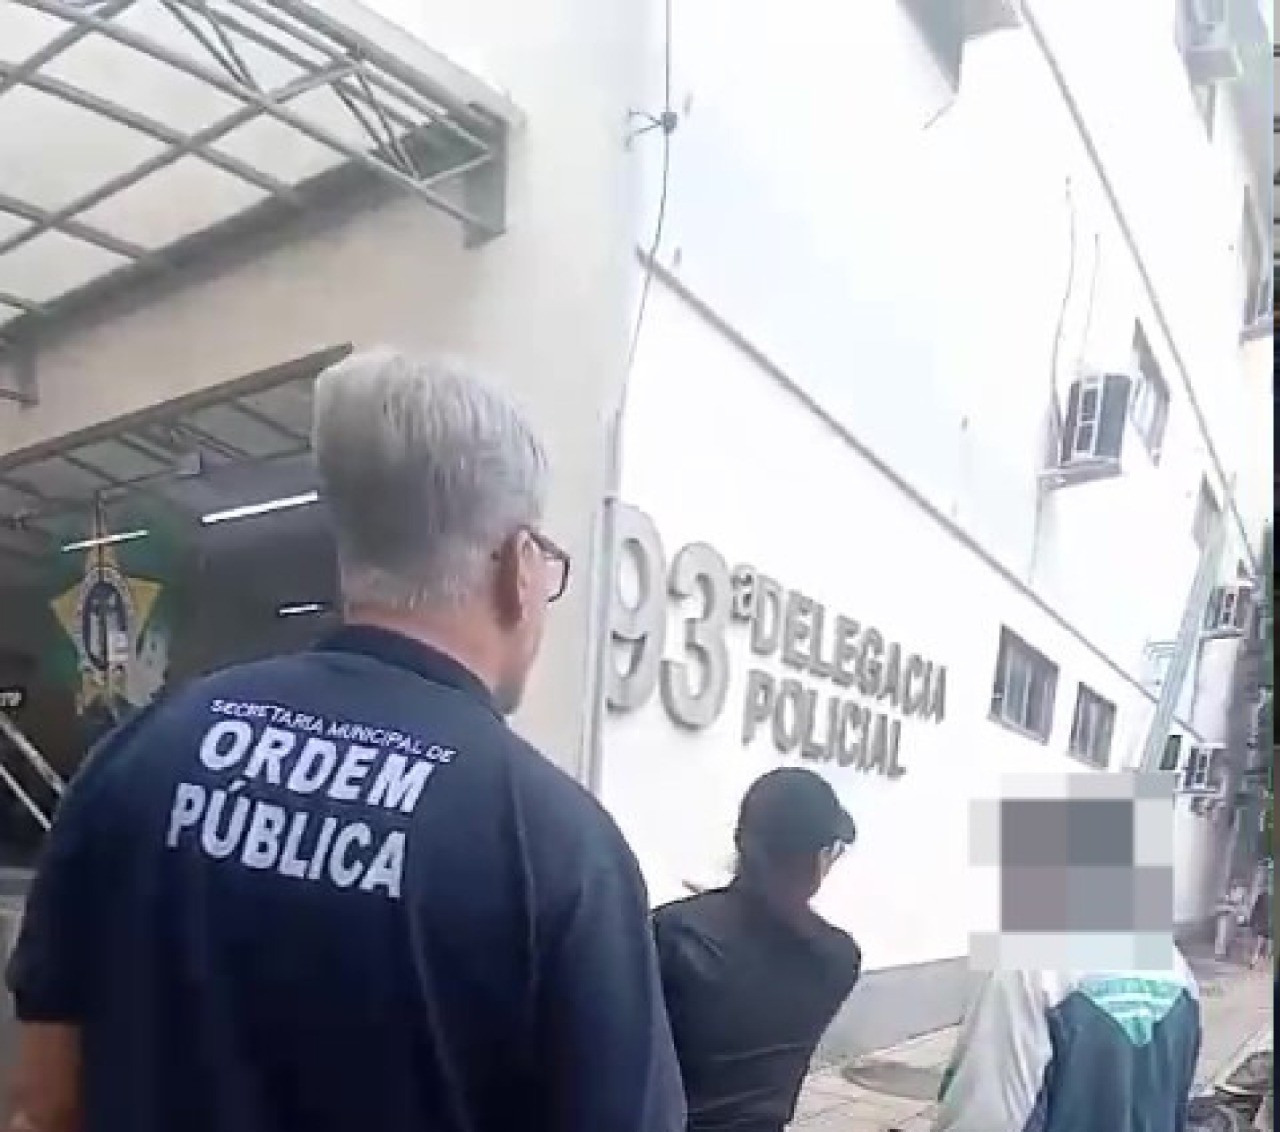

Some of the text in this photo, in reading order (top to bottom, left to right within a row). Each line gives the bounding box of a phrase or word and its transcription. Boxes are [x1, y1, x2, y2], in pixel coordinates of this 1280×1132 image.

[751, 573, 948, 725] DELEGACIA
[199, 721, 436, 813] ORDEM
[742, 668, 906, 779] POLICIAL
[167, 780, 407, 898] PÚBLICA
